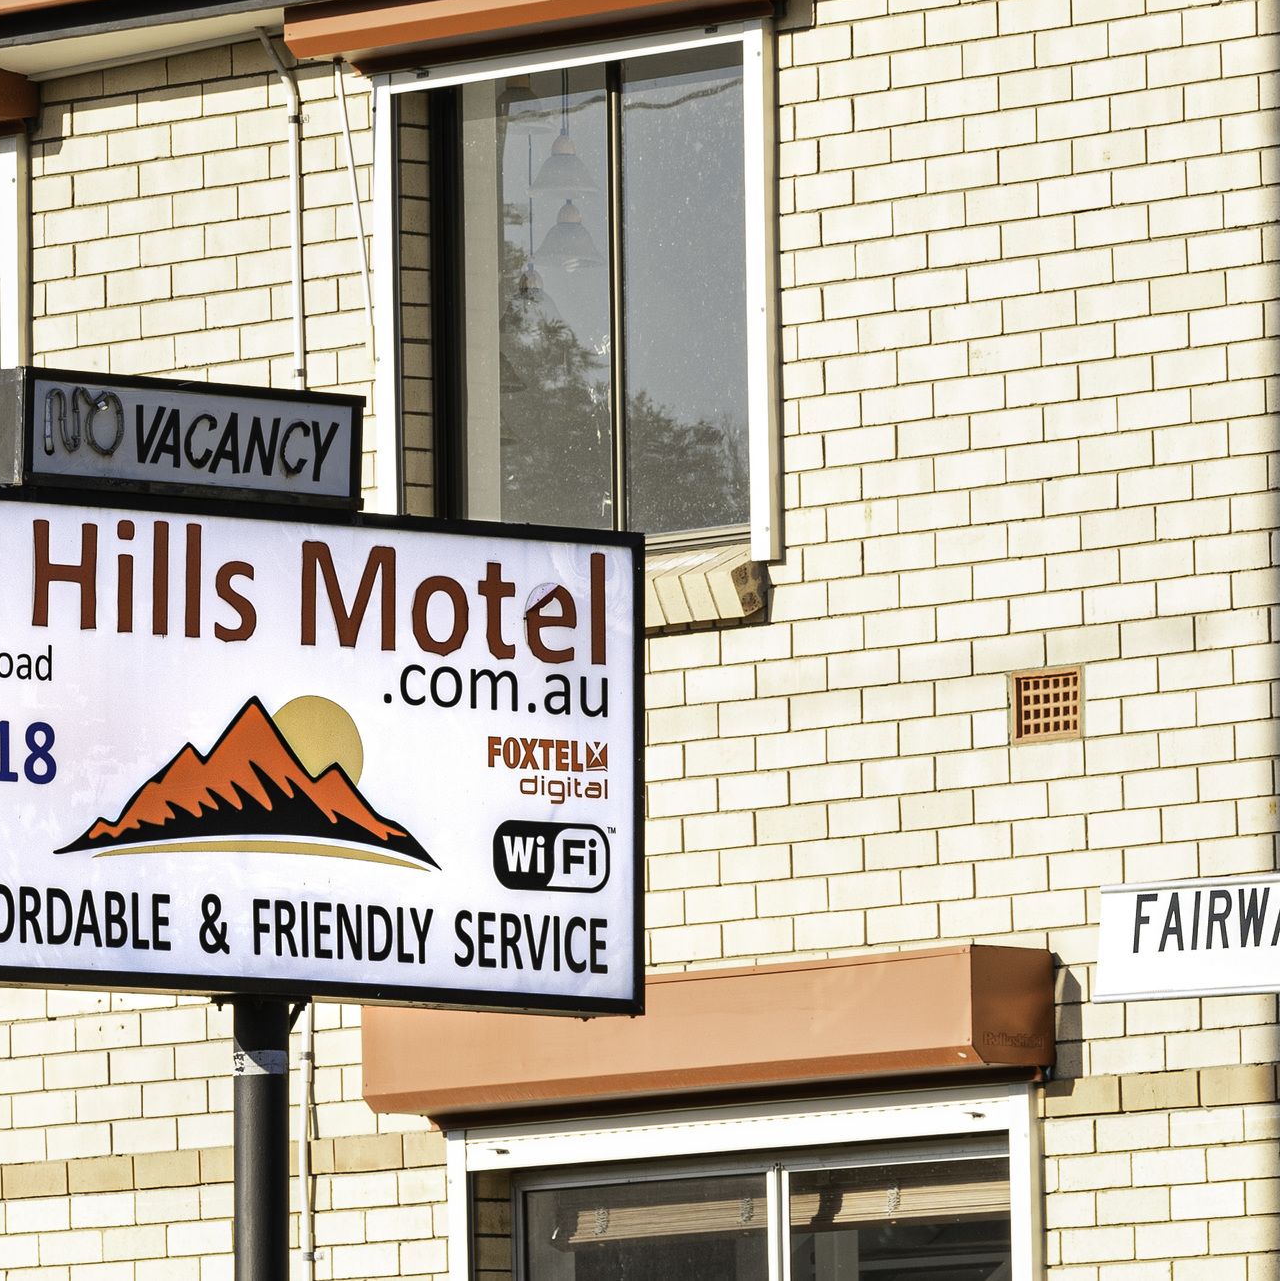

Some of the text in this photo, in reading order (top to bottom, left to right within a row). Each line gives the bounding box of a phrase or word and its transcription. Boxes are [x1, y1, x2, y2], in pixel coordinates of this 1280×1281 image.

[43, 386, 340, 483] NO VACANCY
[31, 518, 257, 643] Hills
[300, 539, 607, 667] Motel
[383, 664, 609, 718] .com.au
[487, 735, 584, 773] FOXTEL
[519, 775, 608, 805] digital
[198, 893, 231, 955] &
[252, 898, 434, 965] FRIENDLY
[454, 909, 609, 975] SERVICE
